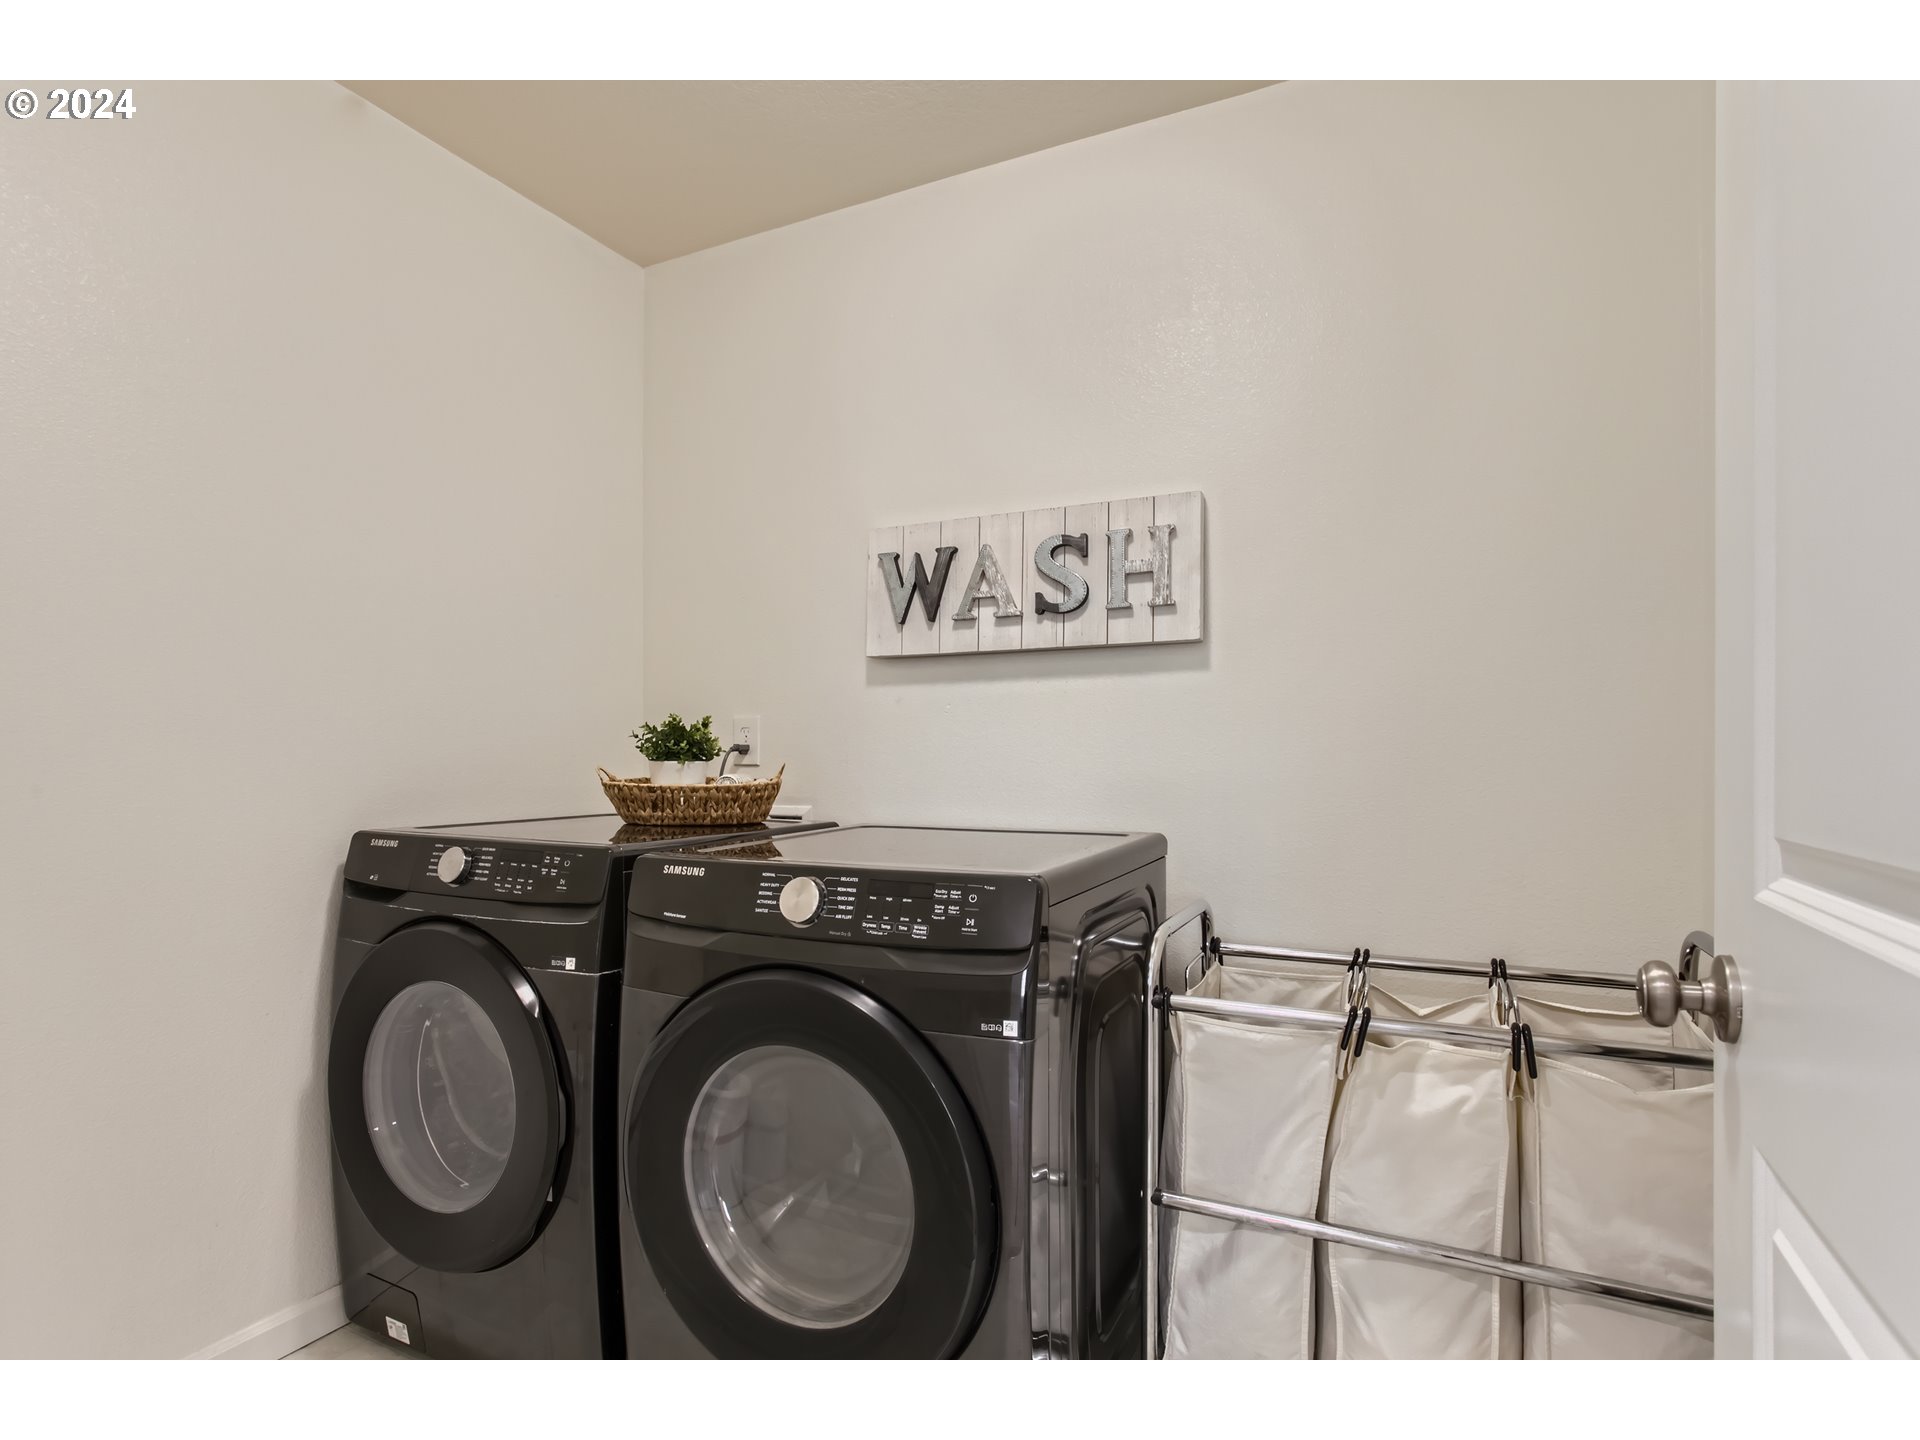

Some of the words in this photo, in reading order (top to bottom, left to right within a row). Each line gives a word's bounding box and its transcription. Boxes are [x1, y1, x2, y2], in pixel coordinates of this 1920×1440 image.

[877, 523, 1177, 625] WASH
[370, 838, 399, 848] SAMSUNG
[663, 864, 705, 876] SAMSUNG
